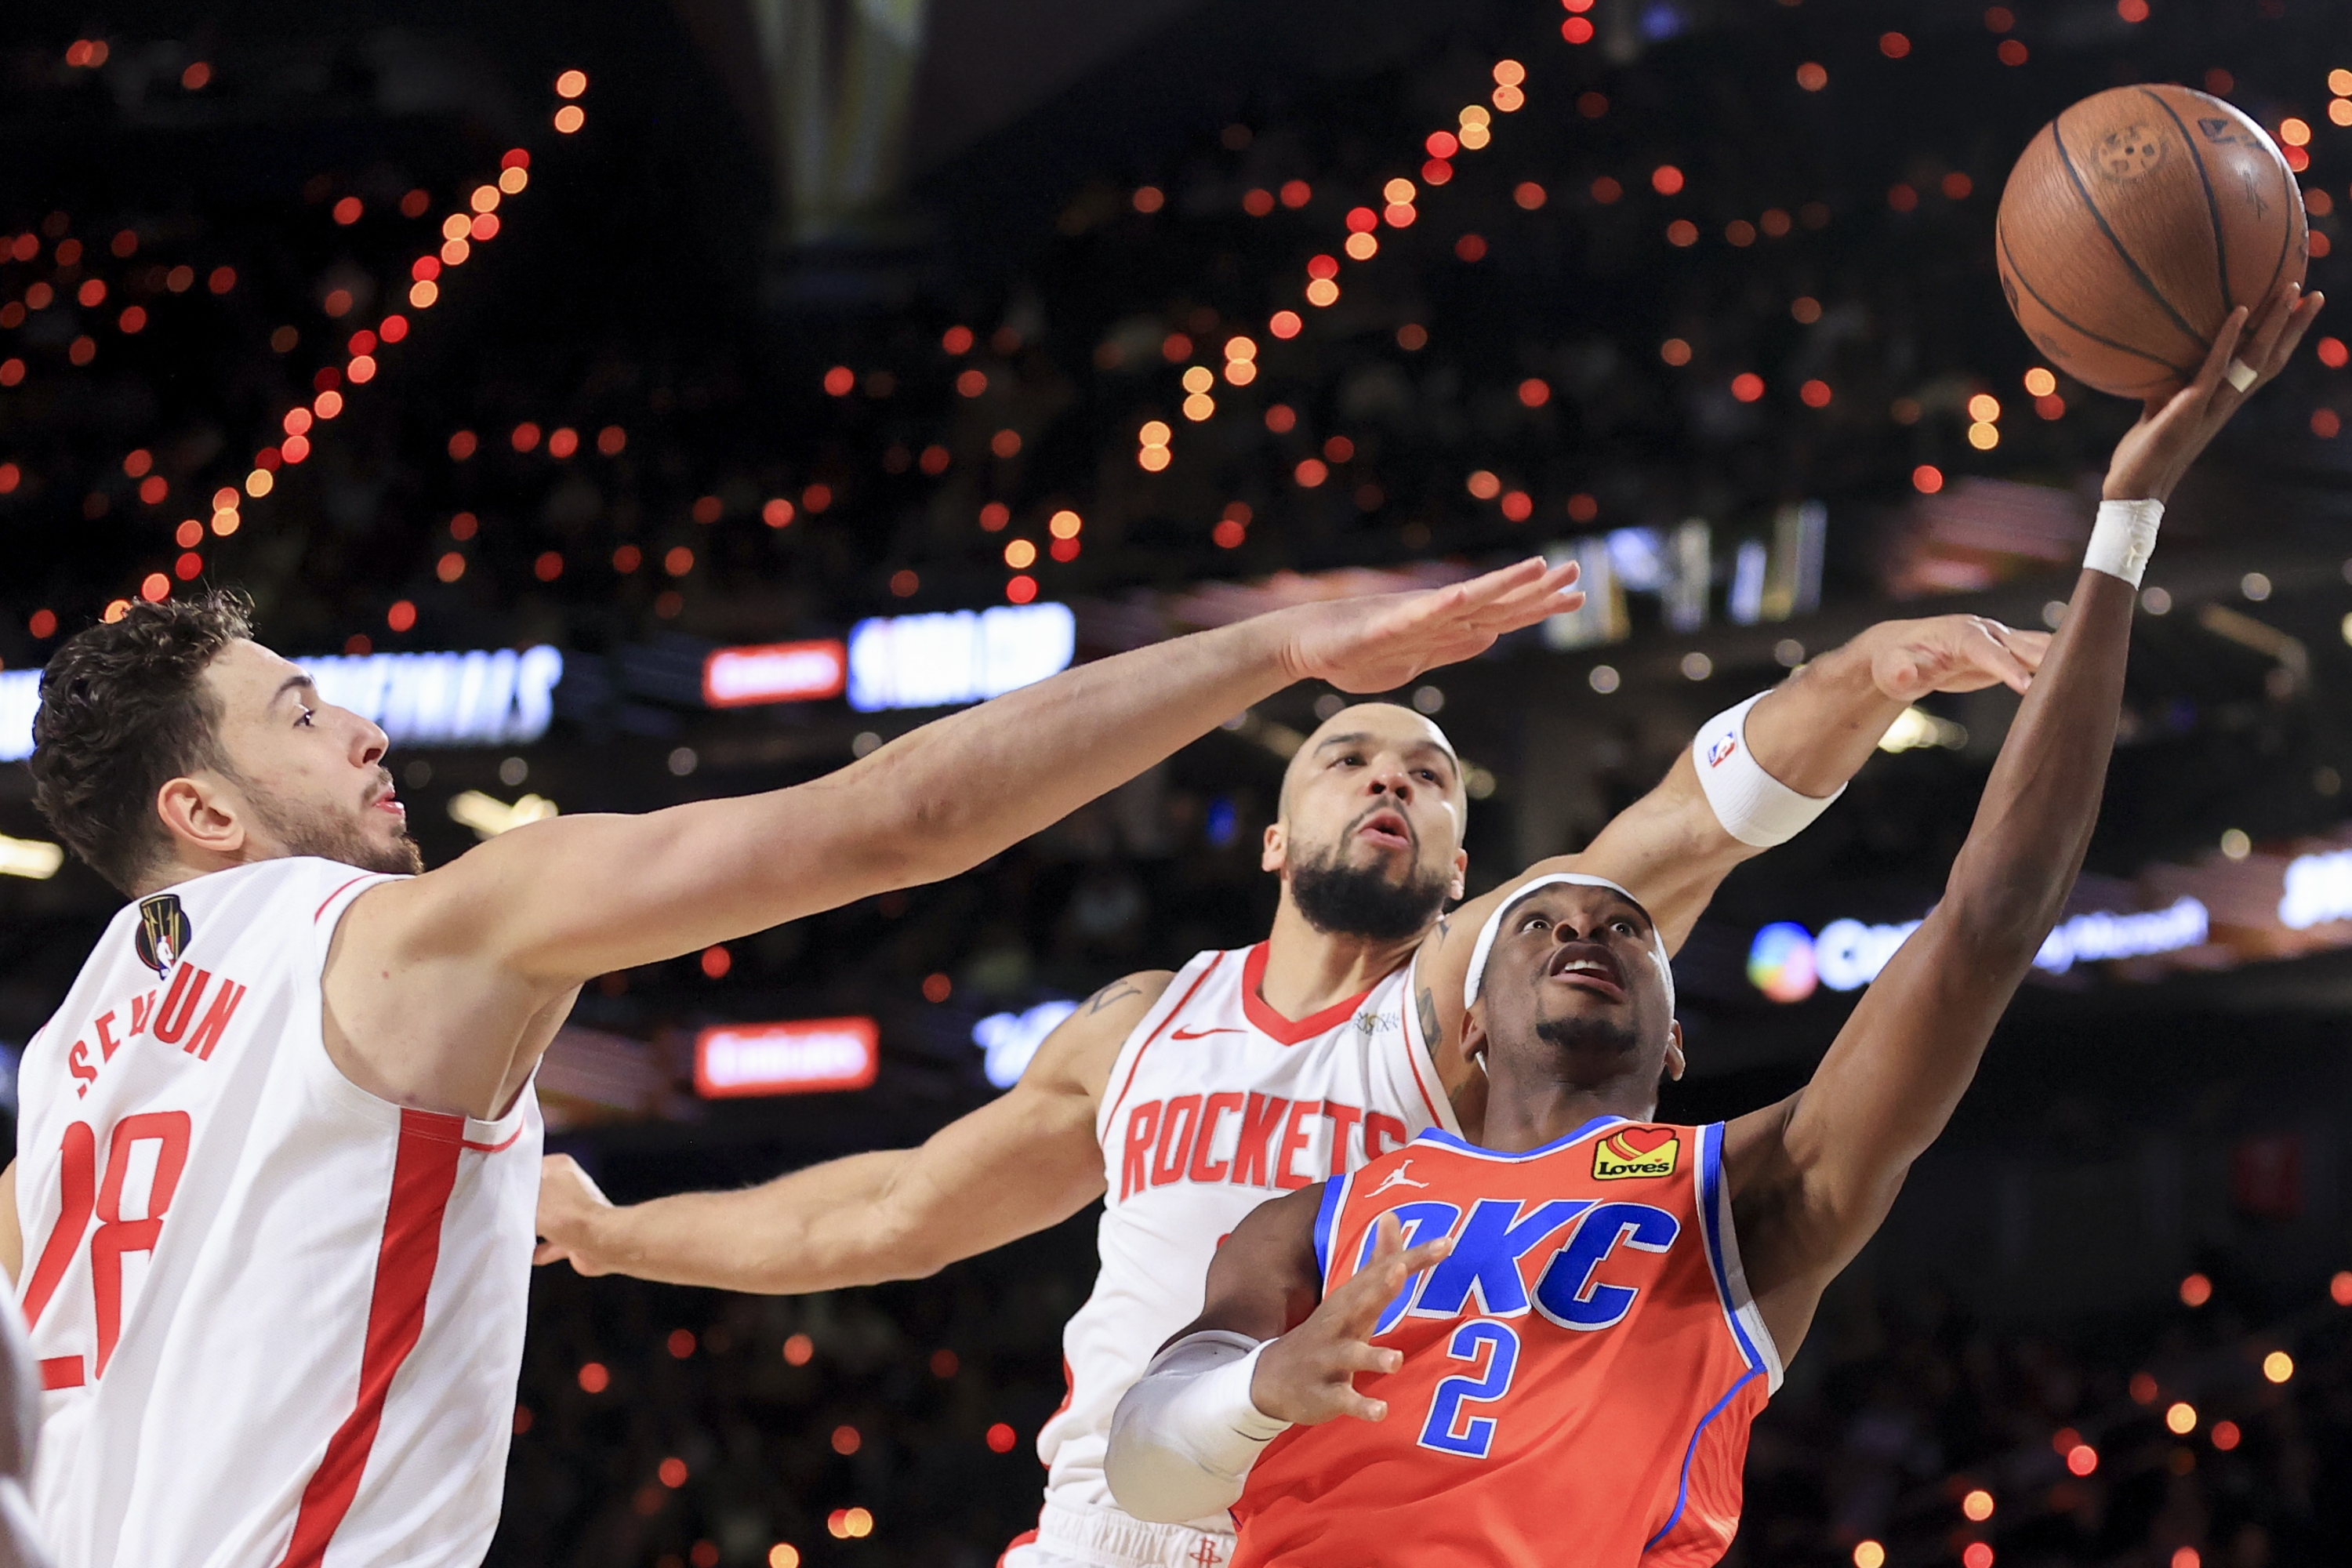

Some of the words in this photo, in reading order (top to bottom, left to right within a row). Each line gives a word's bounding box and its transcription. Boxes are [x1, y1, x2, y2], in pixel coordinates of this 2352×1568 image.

[1597, 1161, 1671, 1176] Loves
[22, 1110, 191, 1392] 28
[1351, 1198, 1681, 1338] OKC
[1416, 1318, 1521, 1459] 2
